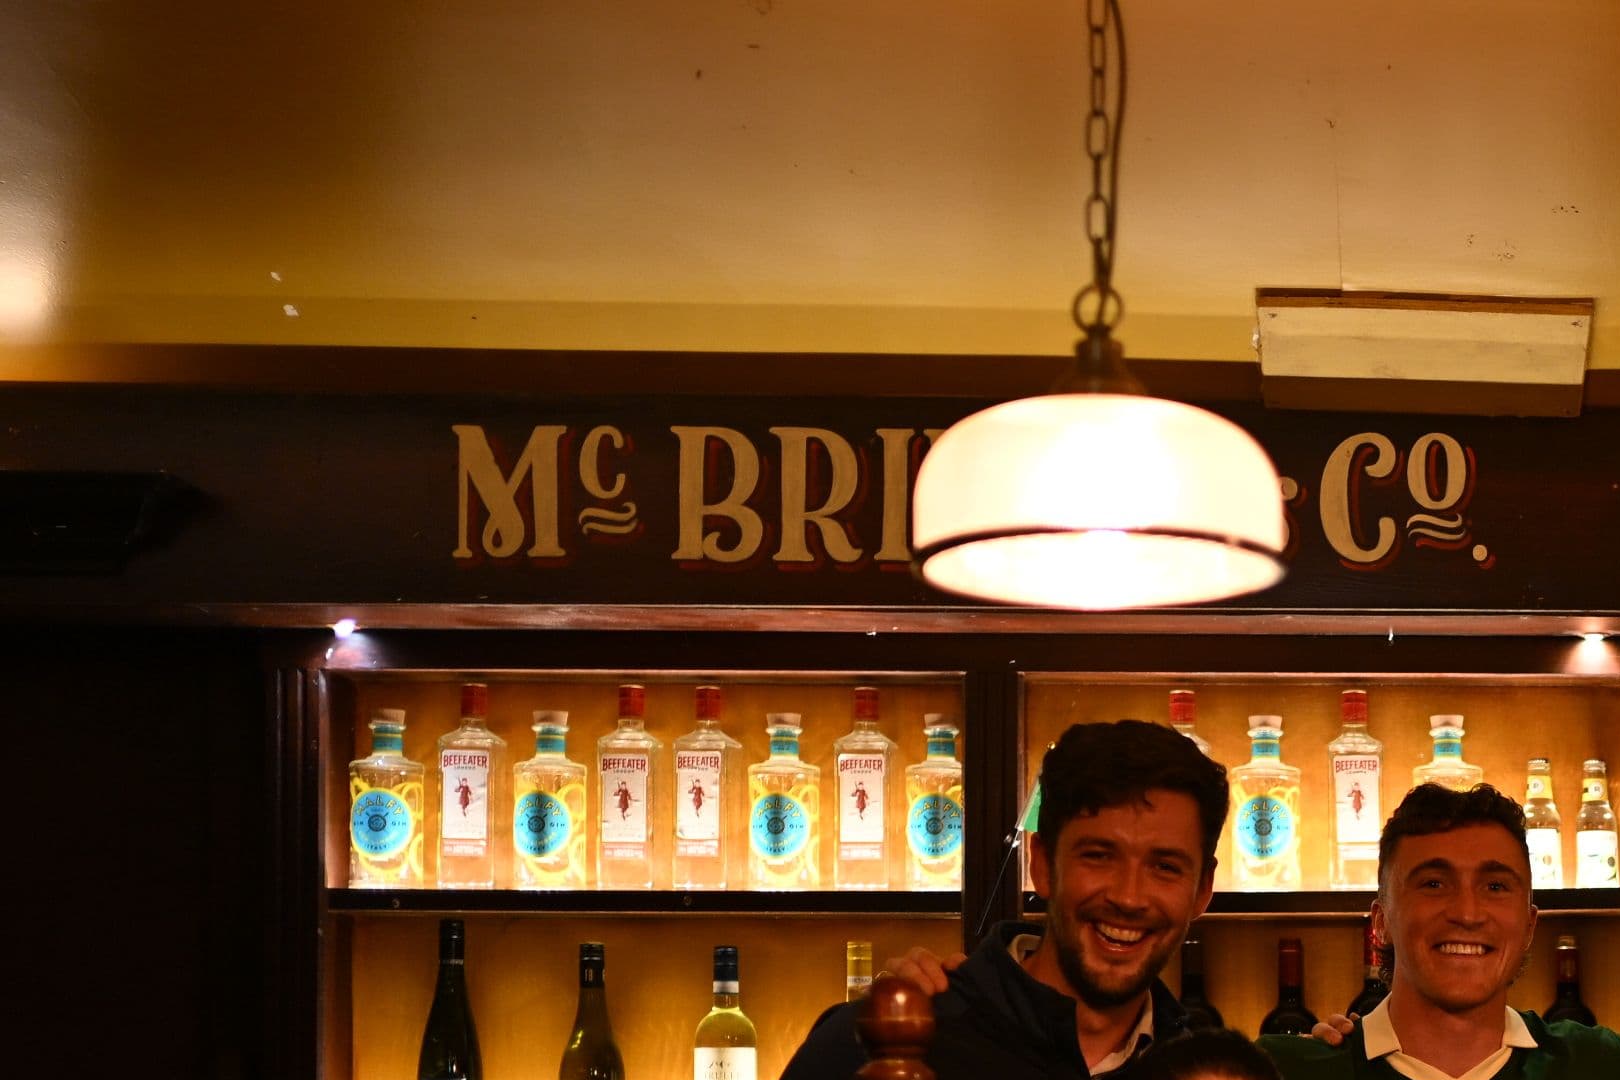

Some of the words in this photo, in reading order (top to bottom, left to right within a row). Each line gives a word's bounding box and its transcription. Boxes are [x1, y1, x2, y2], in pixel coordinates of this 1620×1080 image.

[671, 425, 950, 562] BRI
[442, 754, 488, 768] BEEFEATER
[602, 758, 647, 772] BEEFEATER
[677, 755, 720, 769] BEEFEATER
[840, 759, 883, 772] BEEFEATER
[1335, 759, 1378, 774] BEEFEATER
